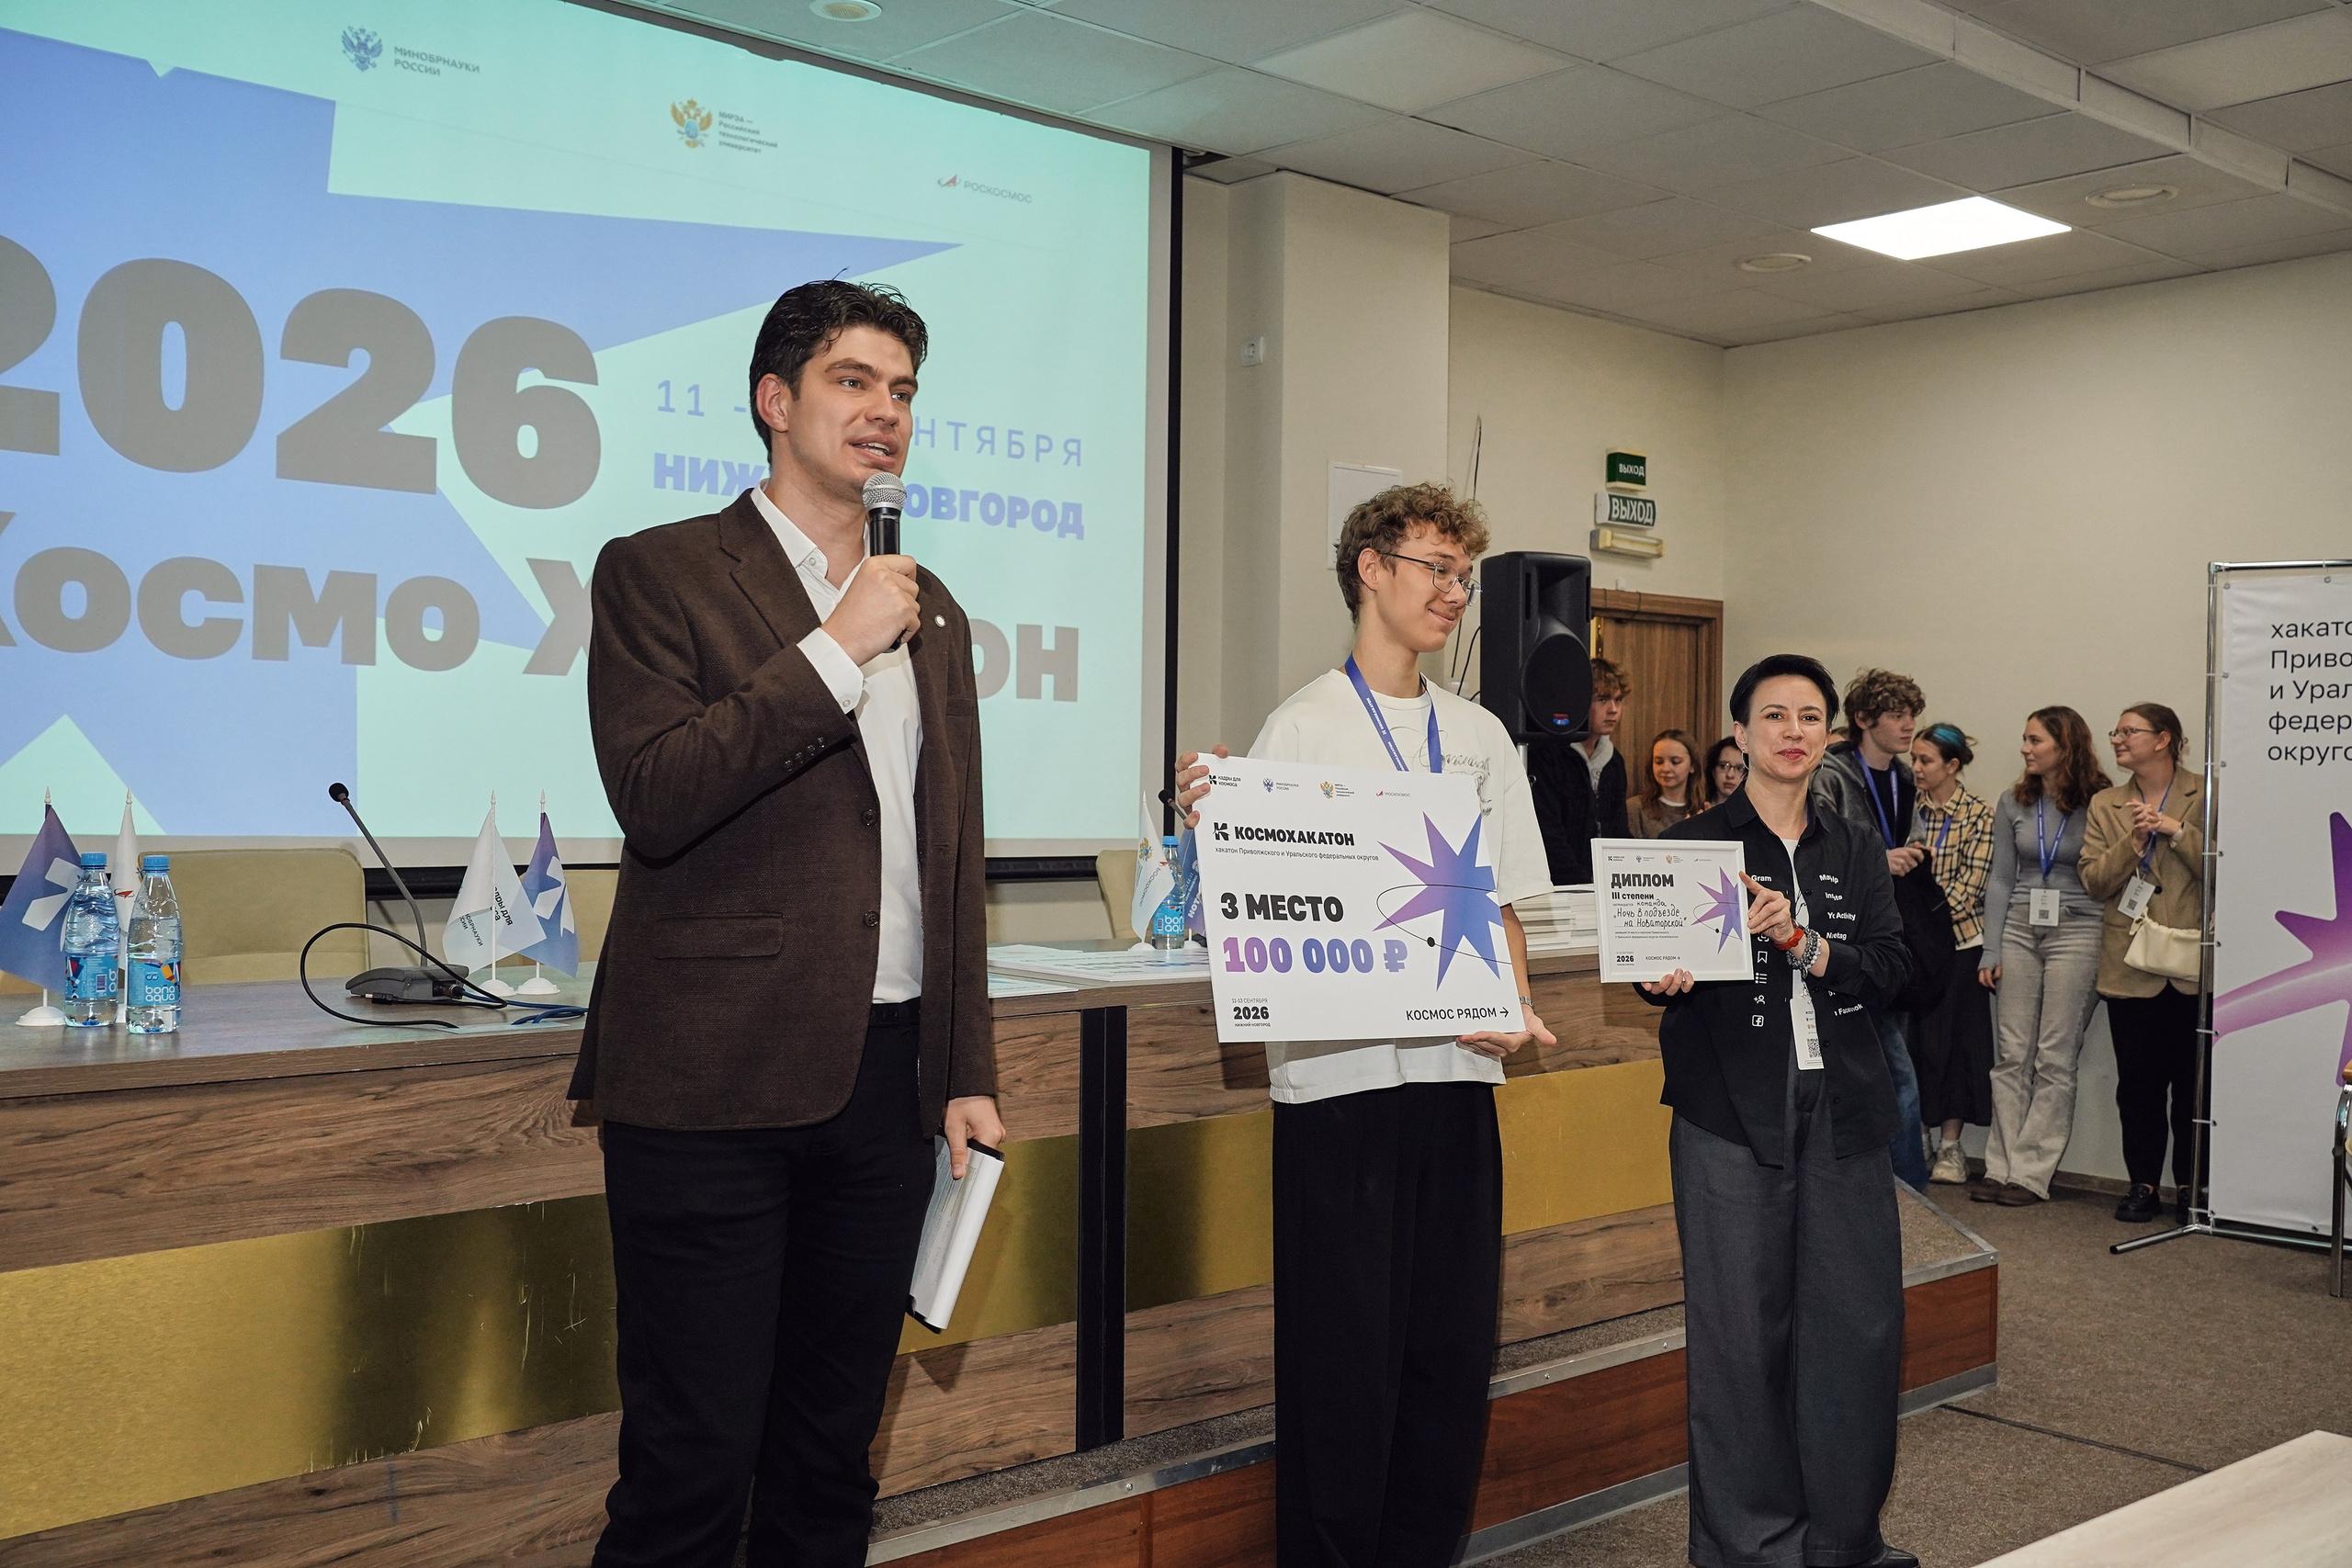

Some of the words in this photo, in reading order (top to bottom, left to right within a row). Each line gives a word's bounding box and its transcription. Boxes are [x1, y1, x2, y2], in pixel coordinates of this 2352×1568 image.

[393, 46, 481, 73] МИНОБРНАУКИ
[393, 58, 441, 76] РОССИИ
[718, 111, 744, 122] МИРЭА
[964, 180, 1032, 203] РОСКОСМОС
[656, 379, 706, 417] 11
[913, 416, 1082, 468] НТЯБРЯ
[1619, 463, 1645, 477] ВЫХОД
[653, 452, 766, 497] НИЖ
[904, 483, 1084, 540] ОВГОРОД
[1611, 497, 1654, 525] ВЫХОД
[0, 511, 480, 671] осмо
[2271, 650, 2352, 673] Приво
[2270, 684, 2283, 699] и
[2292, 680, 2352, 704] Урал
[2268, 711, 2352, 735] федер
[1234, 826, 1355, 846] КОСМОХАКАТОН
[1238, 847, 1280, 857] Приволжского
[1286, 851, 1318, 859] Уральского
[1318, 852, 1356, 861] федеральных
[1611, 873, 1675, 888] ДИПЛОМ
[1220, 892, 1239, 919] 3
[1245, 893, 1344, 922] МЕСТО
[1636, 898, 1667, 907] команда
[465, 913, 483, 947] ОБРНАУКИ
[1223, 937, 1293, 974] 100
[1302, 938, 1374, 974] 000
[1233, 1006, 1270, 1020] 2026
[1406, 1009, 1454, 1021] КОСМОС
[1457, 1007, 1498, 1020] РЯДОМ
